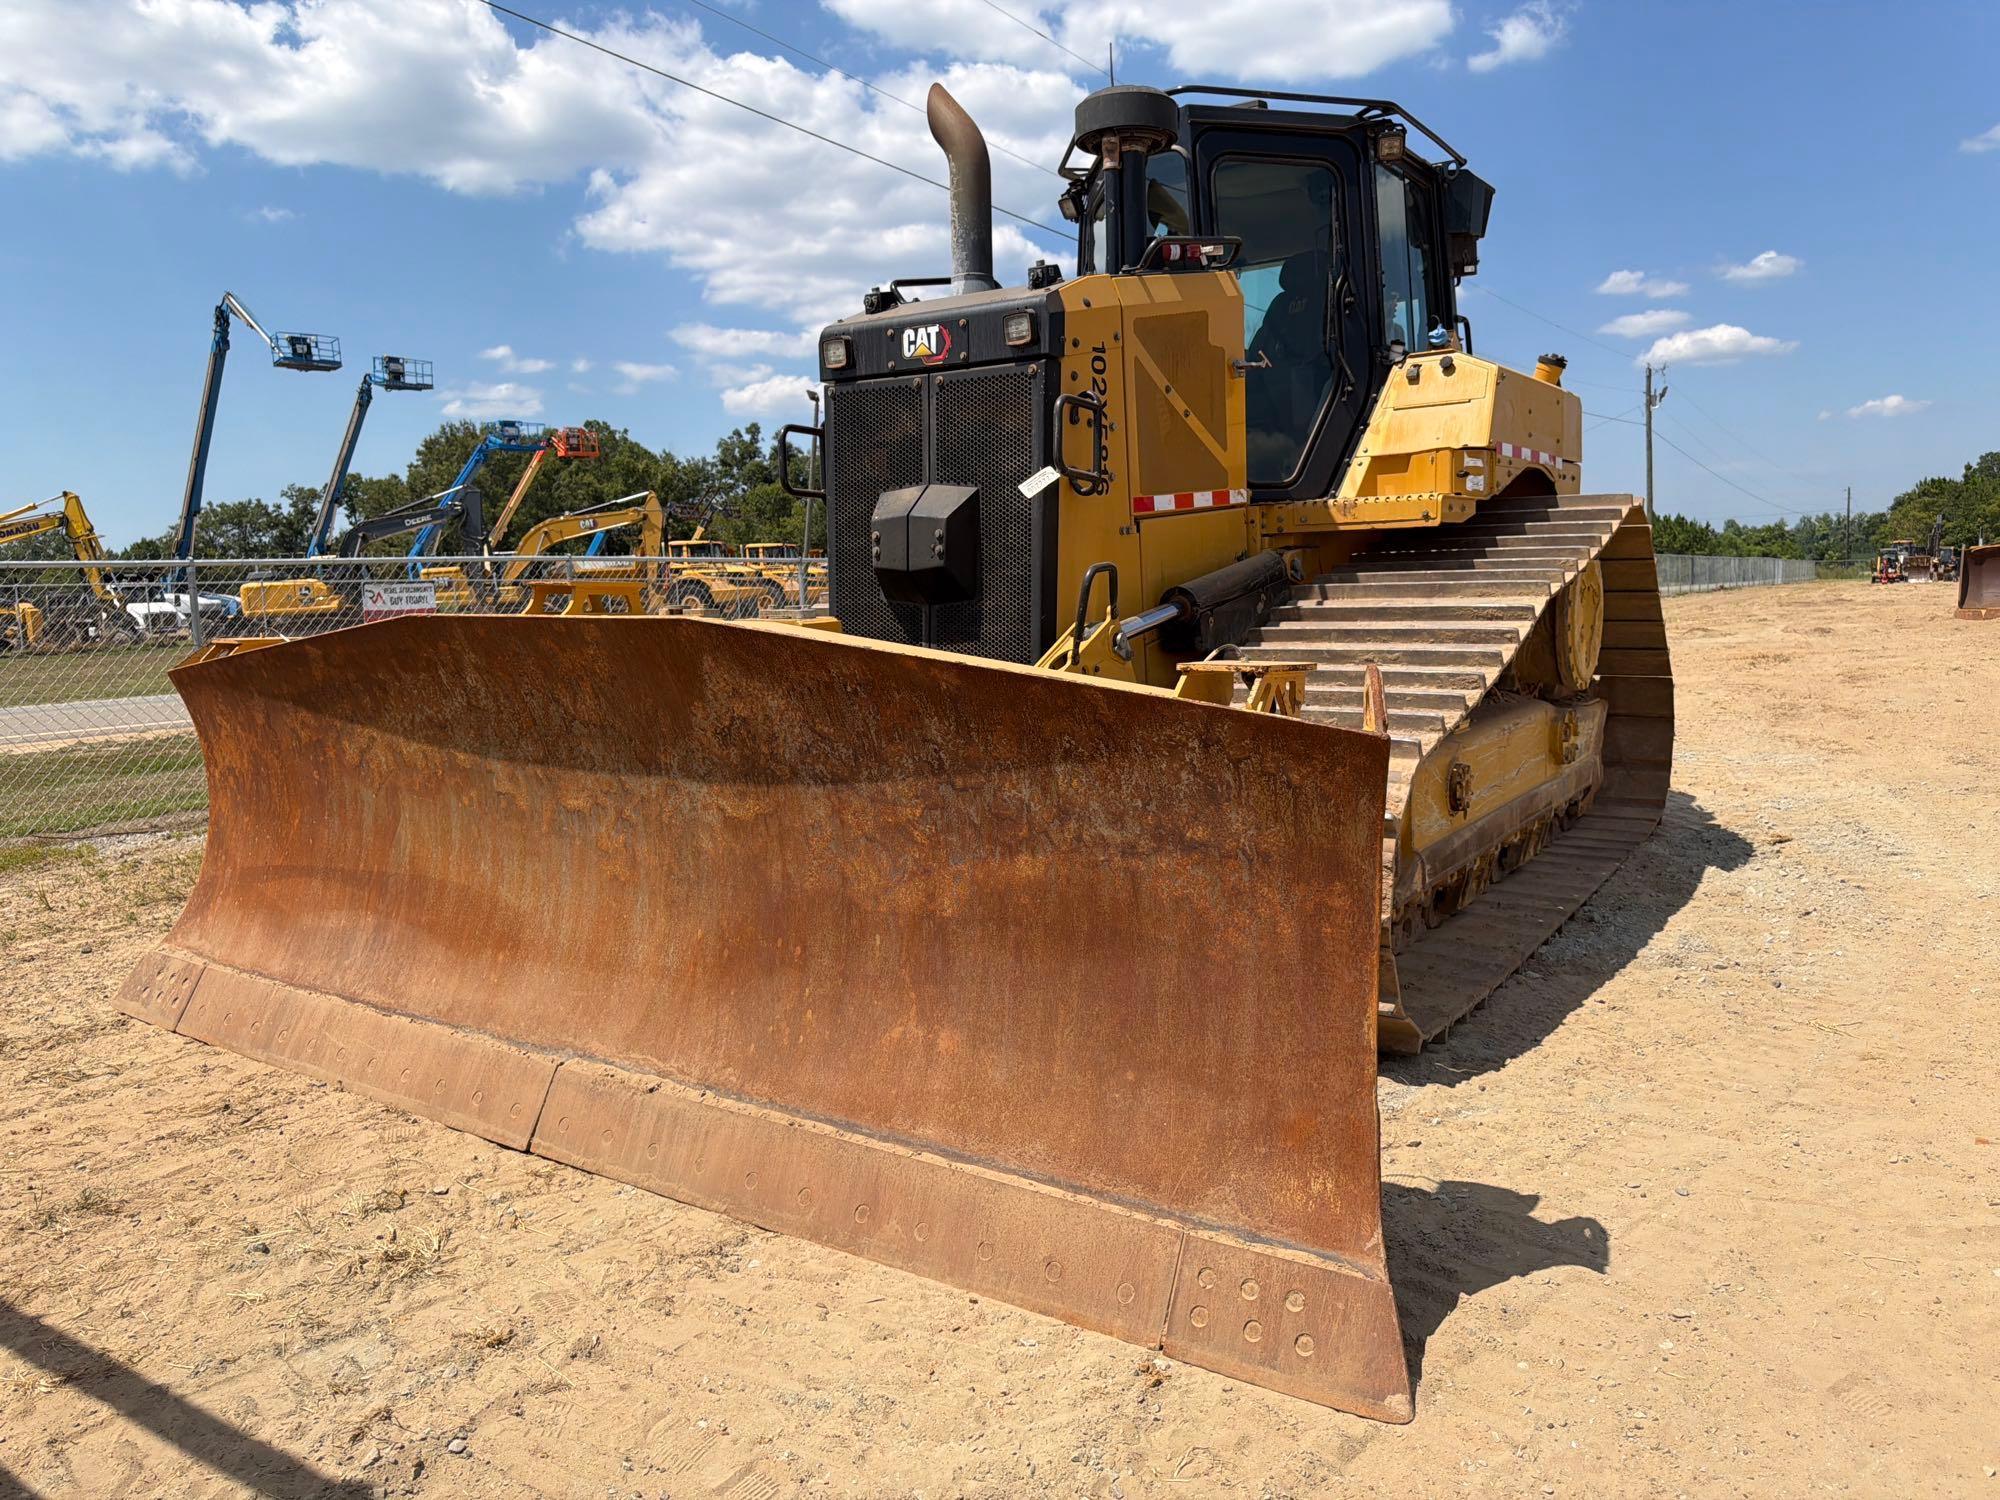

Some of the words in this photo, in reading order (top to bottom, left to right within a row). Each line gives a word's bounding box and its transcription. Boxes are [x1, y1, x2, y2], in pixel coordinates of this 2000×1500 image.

[903, 324, 939, 357] CAT
[404, 514, 432, 526] DEERE
[580, 518, 594, 529] CAT
